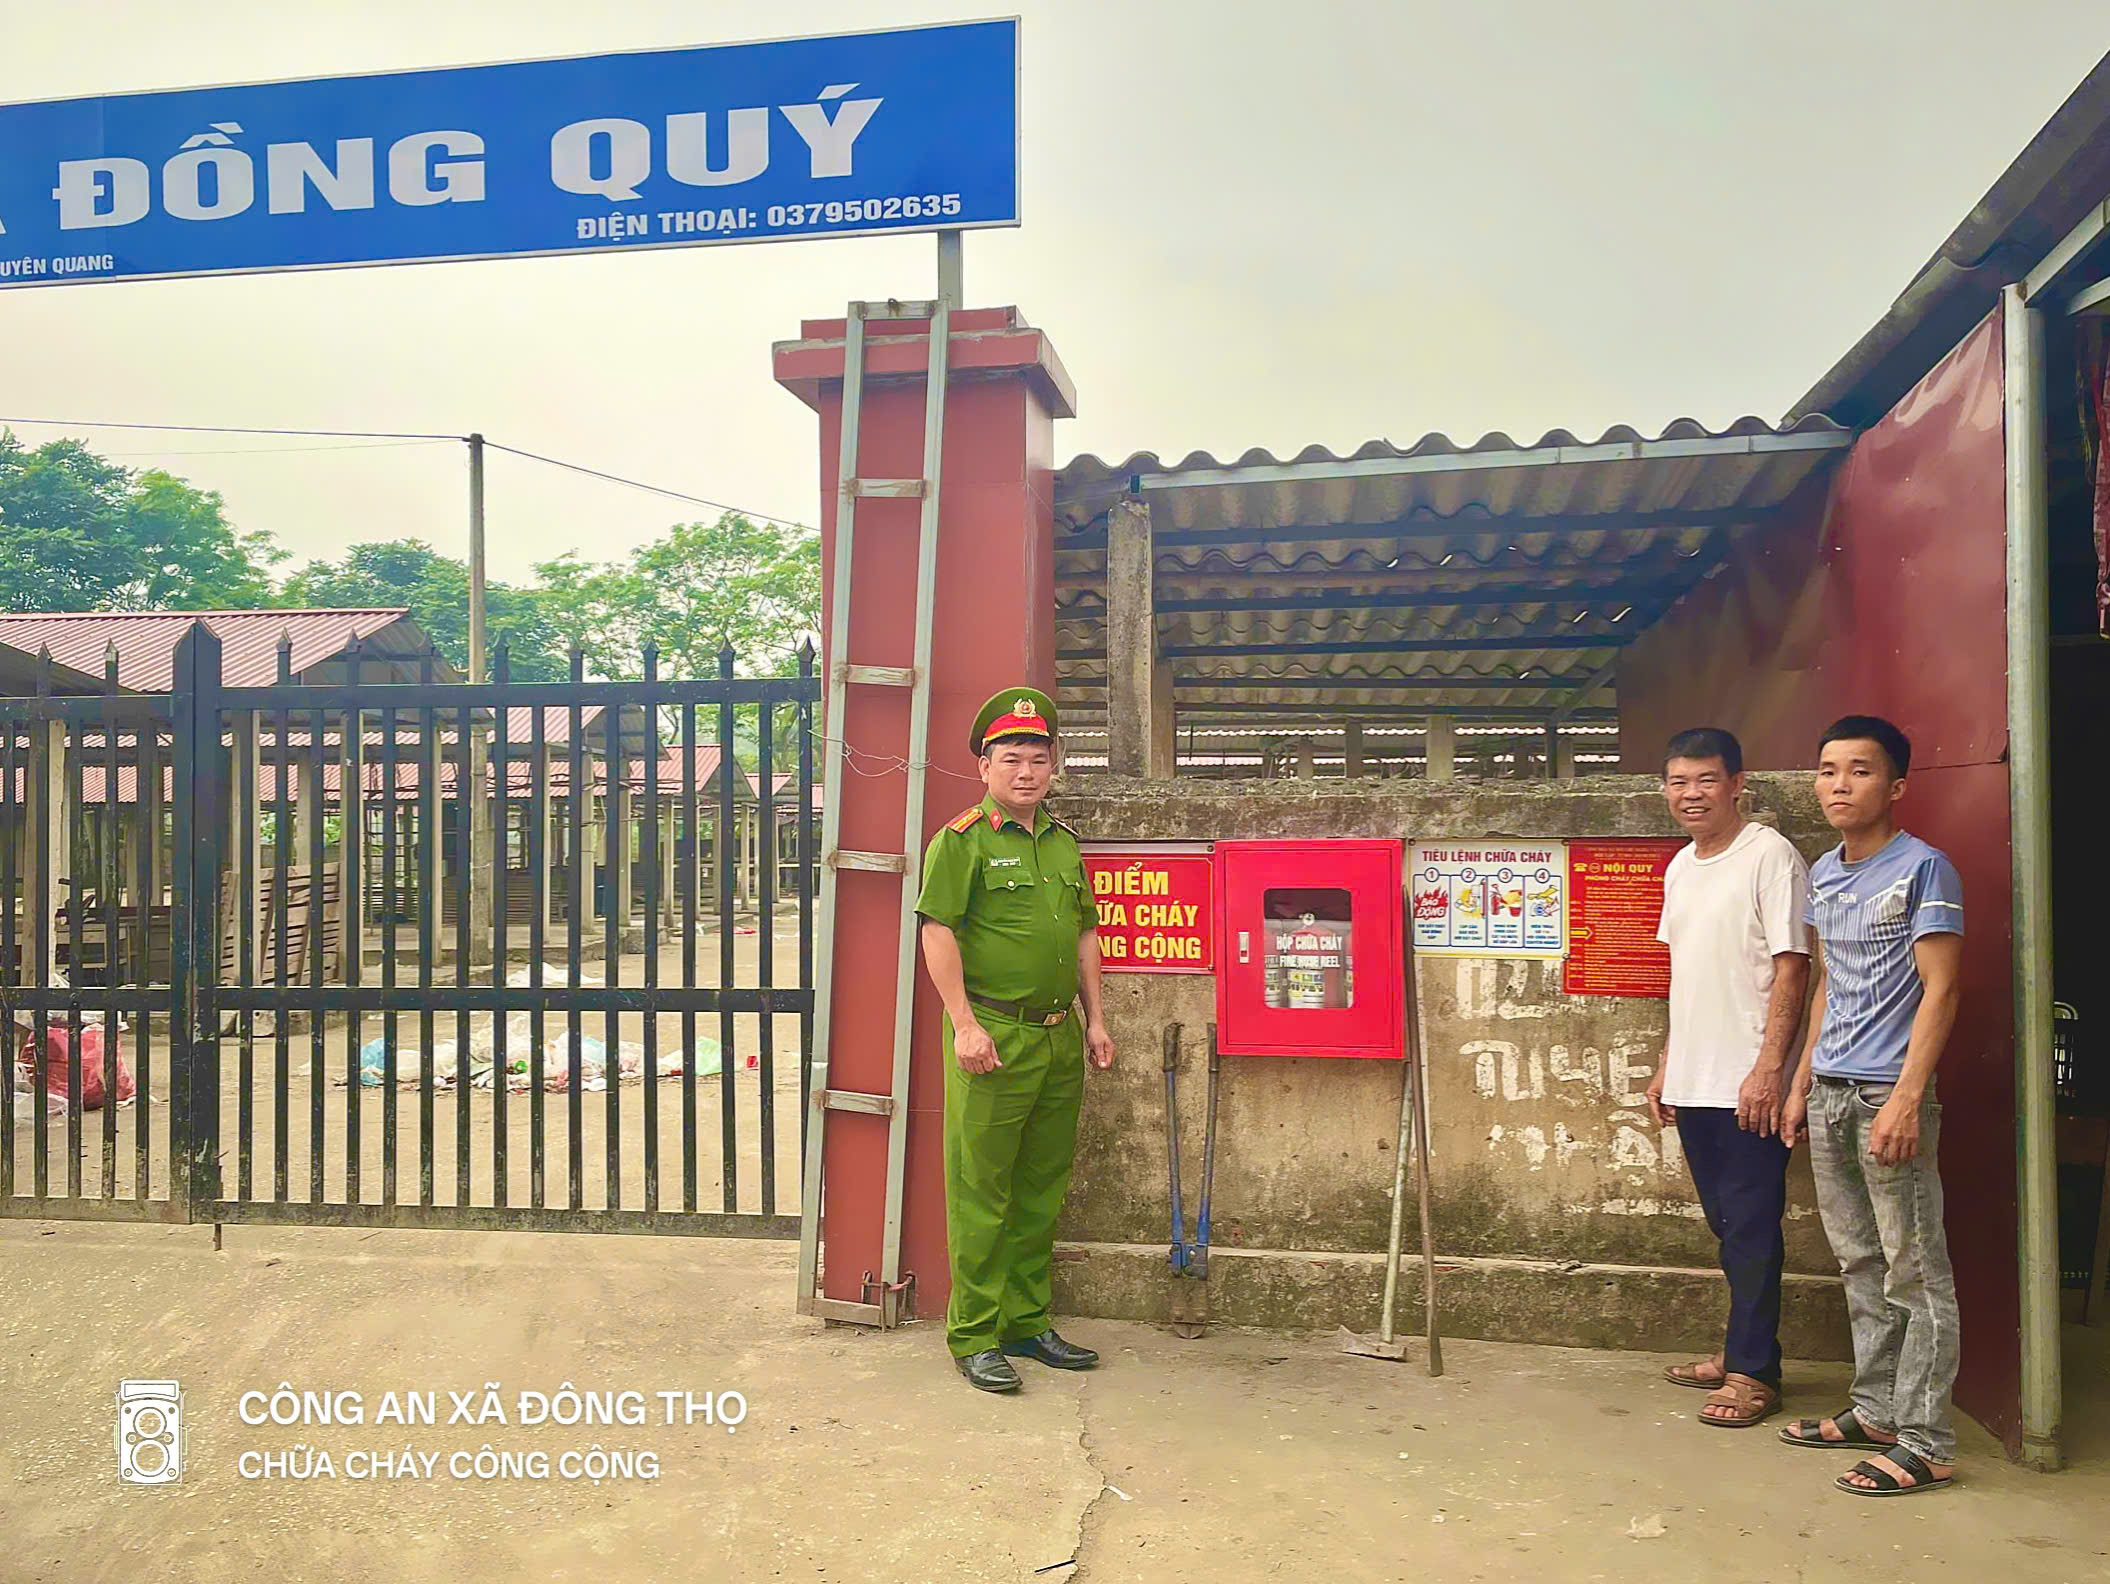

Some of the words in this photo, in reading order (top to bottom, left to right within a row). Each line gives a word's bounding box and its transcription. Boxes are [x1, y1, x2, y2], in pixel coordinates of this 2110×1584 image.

[52, 121, 487, 230] ĐỒNG
[550, 83, 885, 202] QUÝ
[576, 211, 648, 241] ĐIỆN
[658, 206, 757, 235] THOẠI:
[766, 194, 962, 228] 0379502635
[52, 254, 114, 275] QUANG
[1485, 849, 1517, 863] CHỮA
[1520, 850, 1552, 863] CHÁY
[1093, 862, 1169, 895] ĐIỂM
[1429, 870, 1435, 879] 1
[1464, 871, 1473, 879] 2
[1501, 872, 1509, 880] 3
[1537, 872, 1546, 880] 4
[1135, 901, 1199, 927] CHÁY
[1135, 932, 1202, 963] CỘNG
